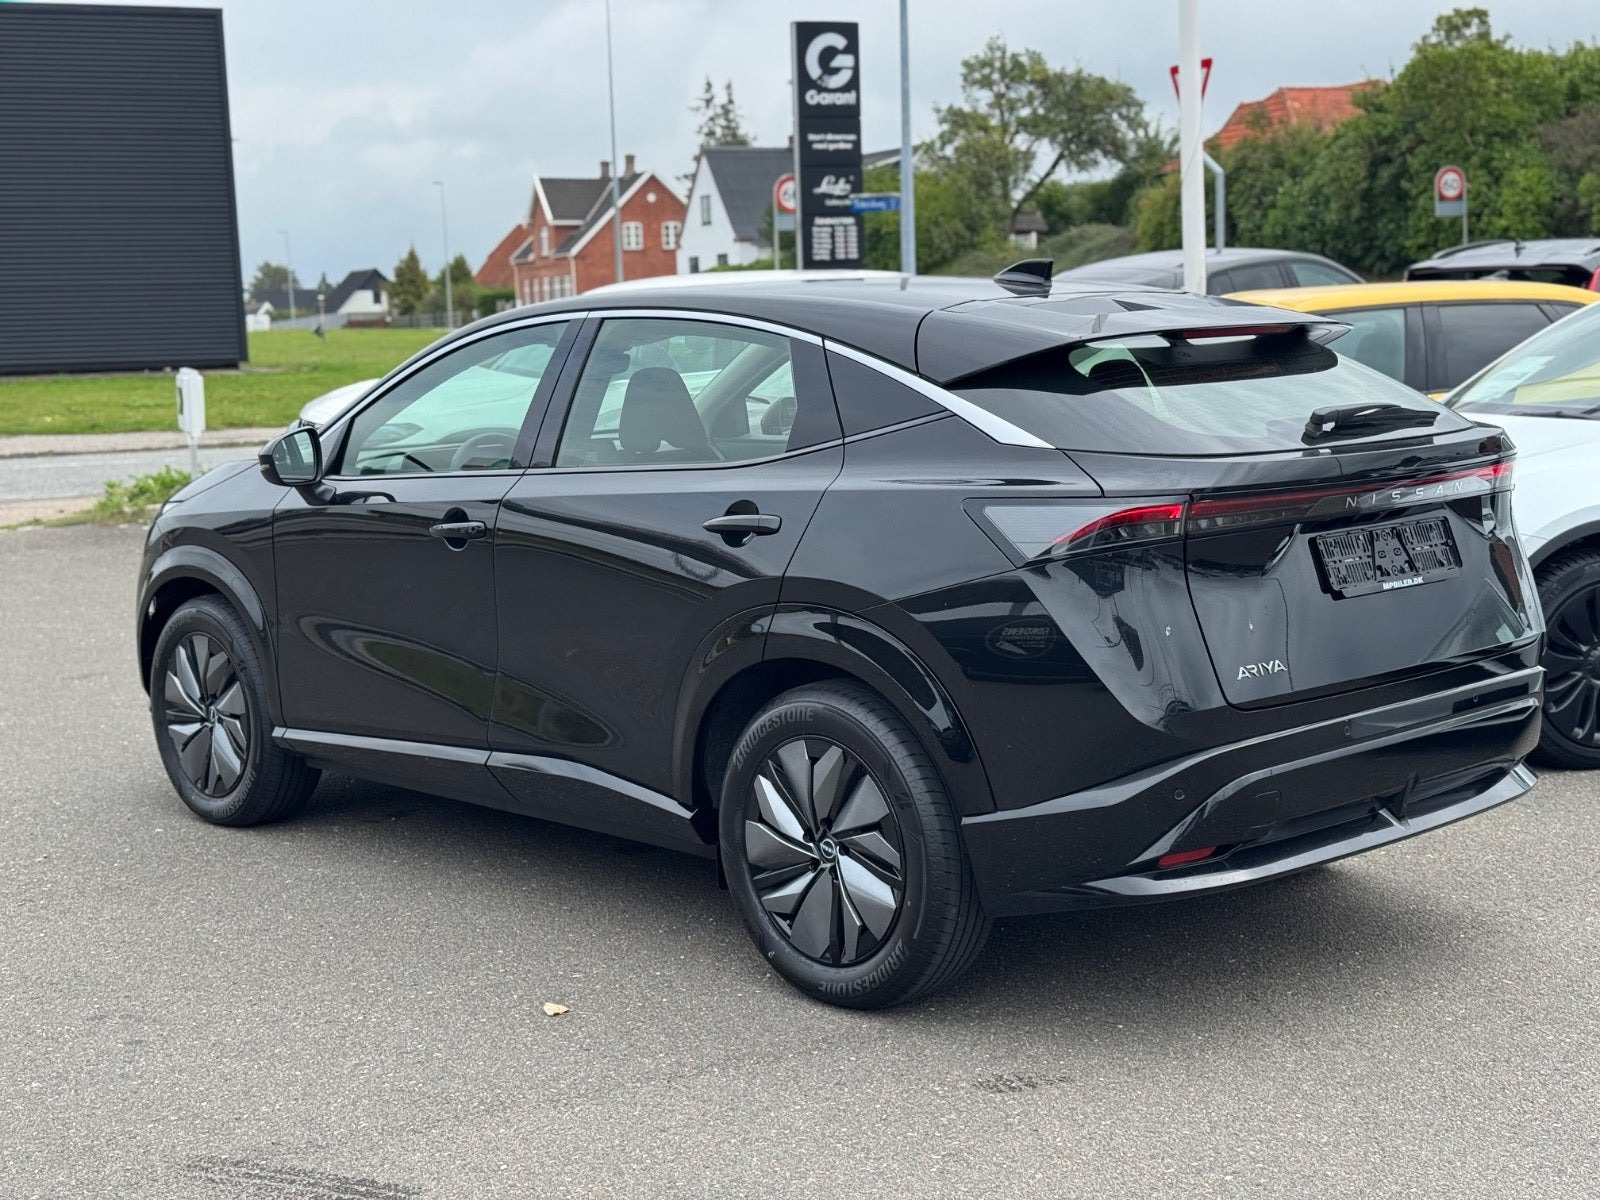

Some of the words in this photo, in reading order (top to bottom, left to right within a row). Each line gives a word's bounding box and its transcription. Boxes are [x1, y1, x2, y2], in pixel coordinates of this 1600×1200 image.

[805, 89, 857, 106] Garant
[1345, 481, 1463, 508] NISSAN
[1382, 576, 1424, 590] MPBILER.DK
[1237, 659, 1288, 680] ARIYA
[733, 706, 814, 771] BRIDGESTONE
[818, 937, 909, 997] BRIDGESTONE
